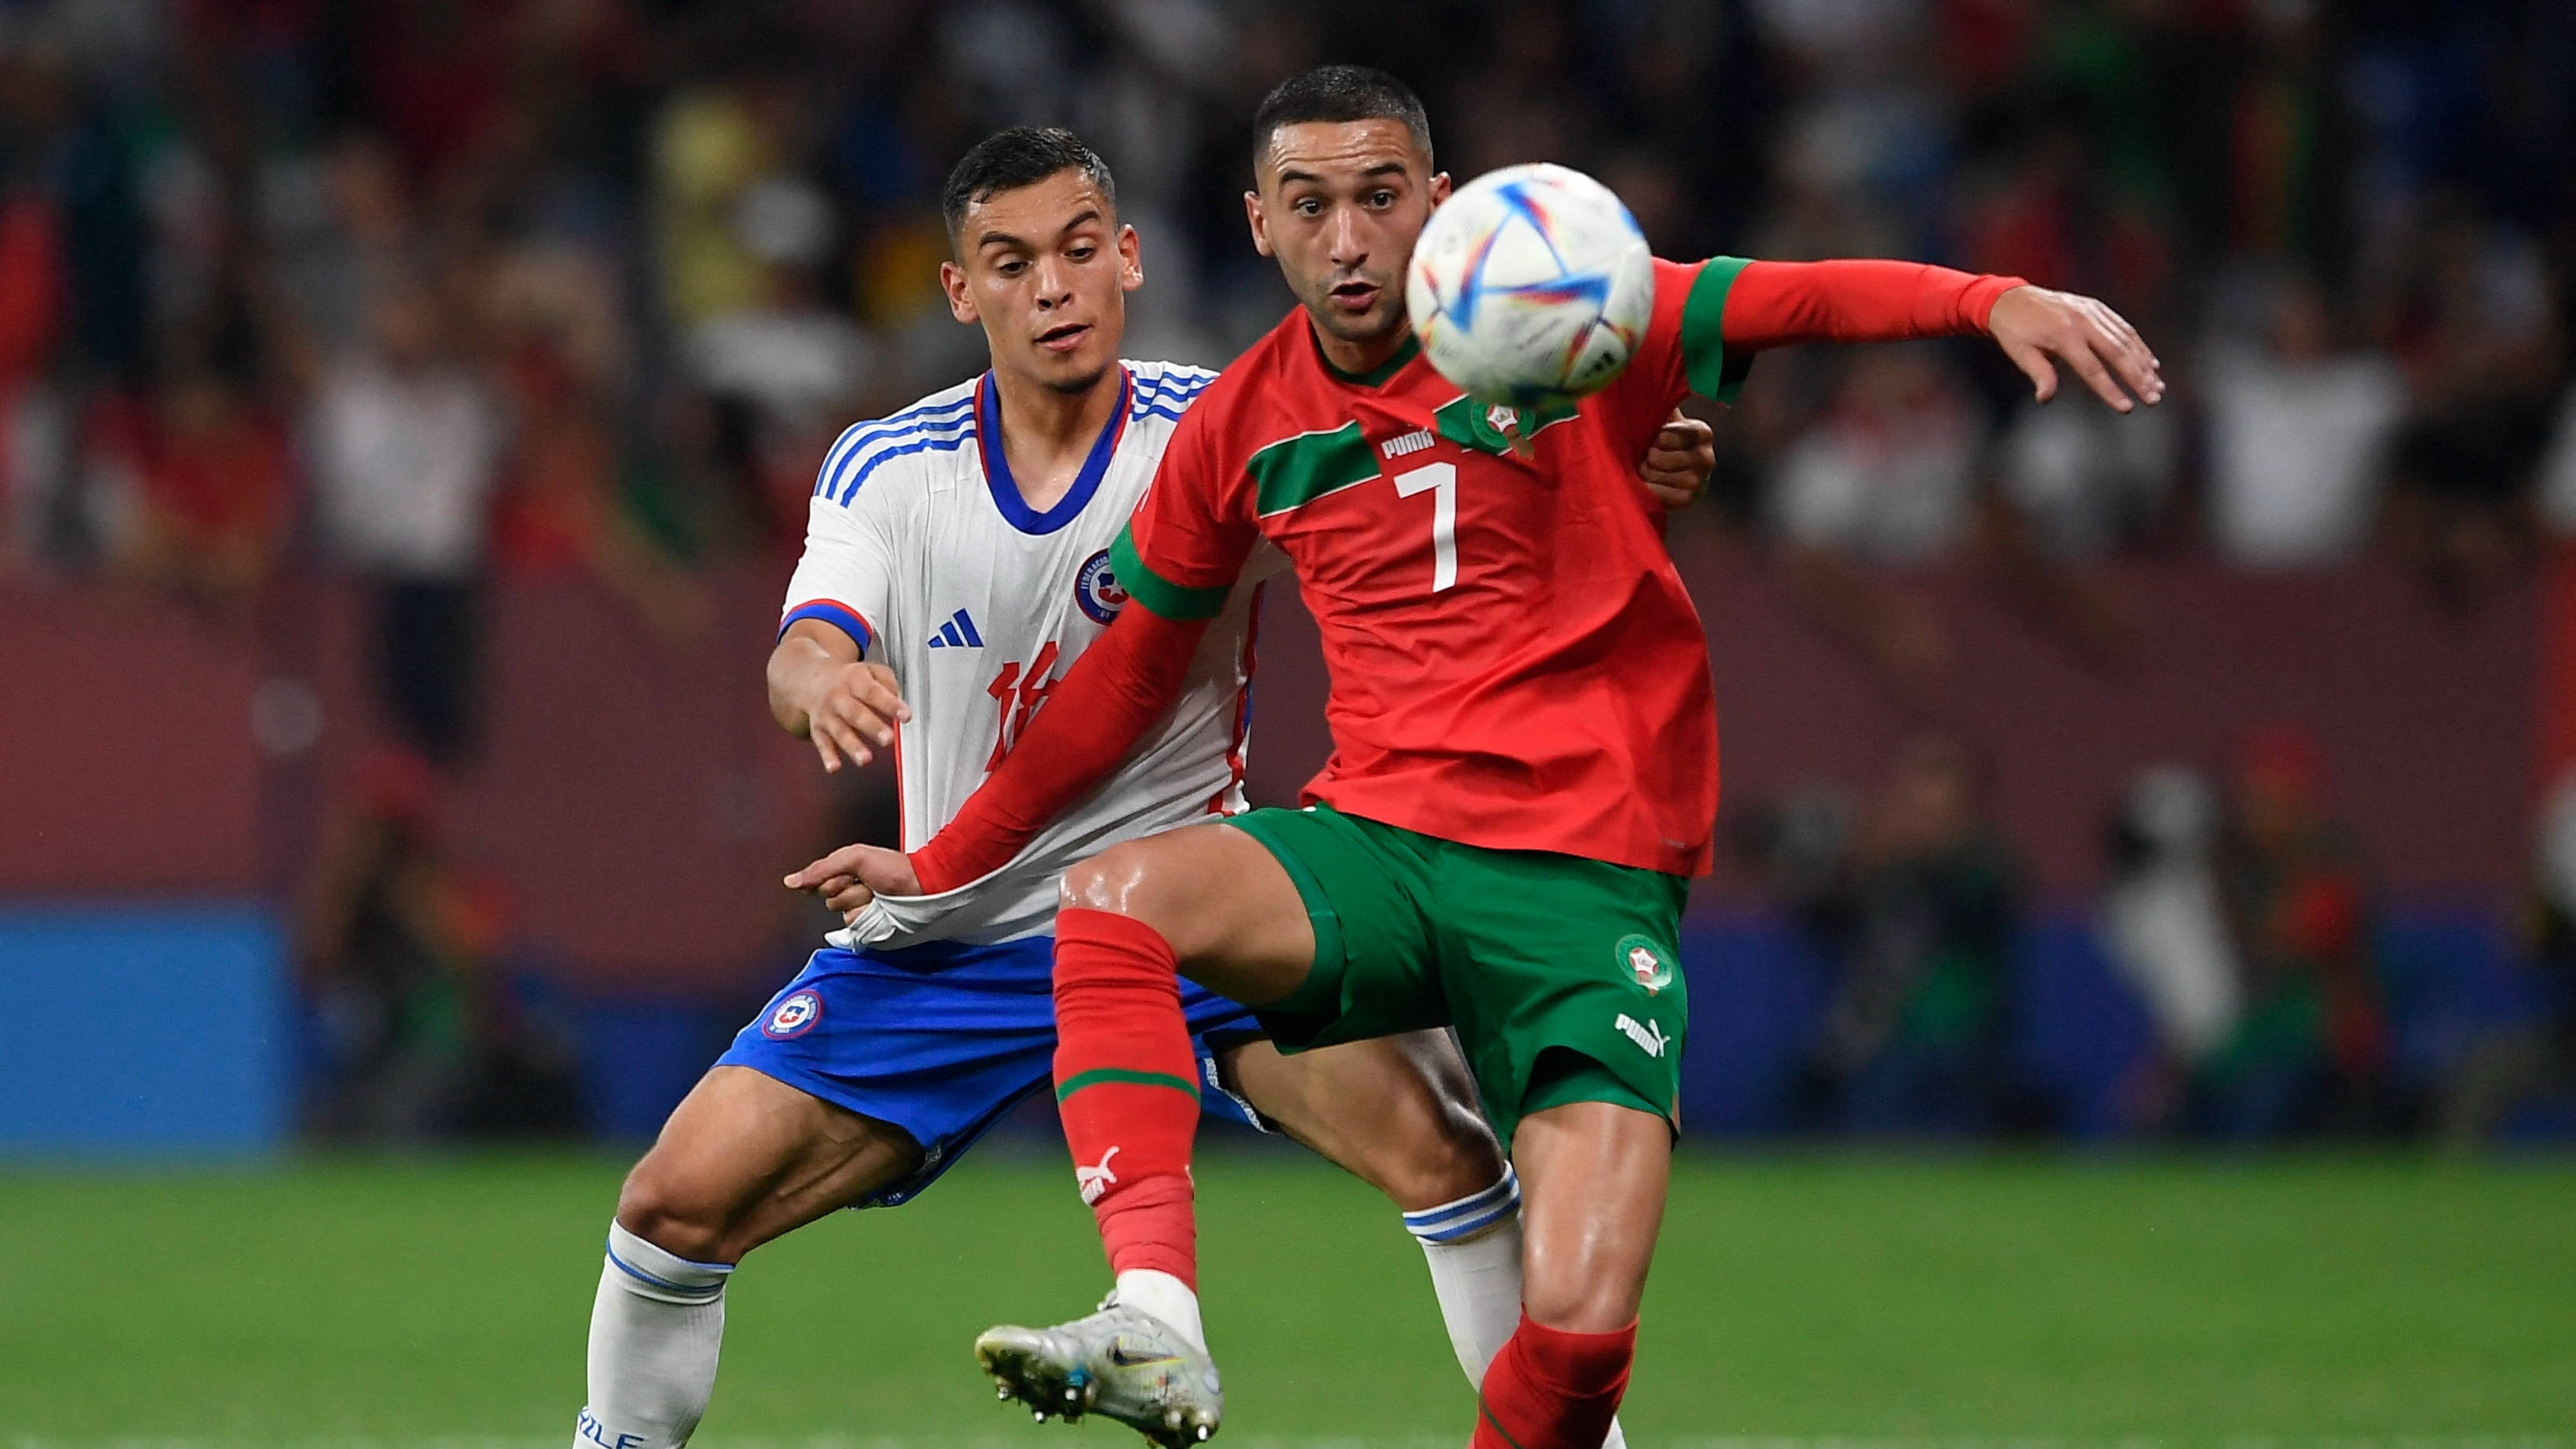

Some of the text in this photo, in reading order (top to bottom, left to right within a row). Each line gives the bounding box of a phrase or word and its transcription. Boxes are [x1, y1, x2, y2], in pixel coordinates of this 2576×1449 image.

[1381, 429, 1435, 460] PUMA
[1394, 462, 1457, 593] 7
[1080, 556, 1109, 590] FEDERACIO
[1615, 1012, 1659, 1058] PUMA
